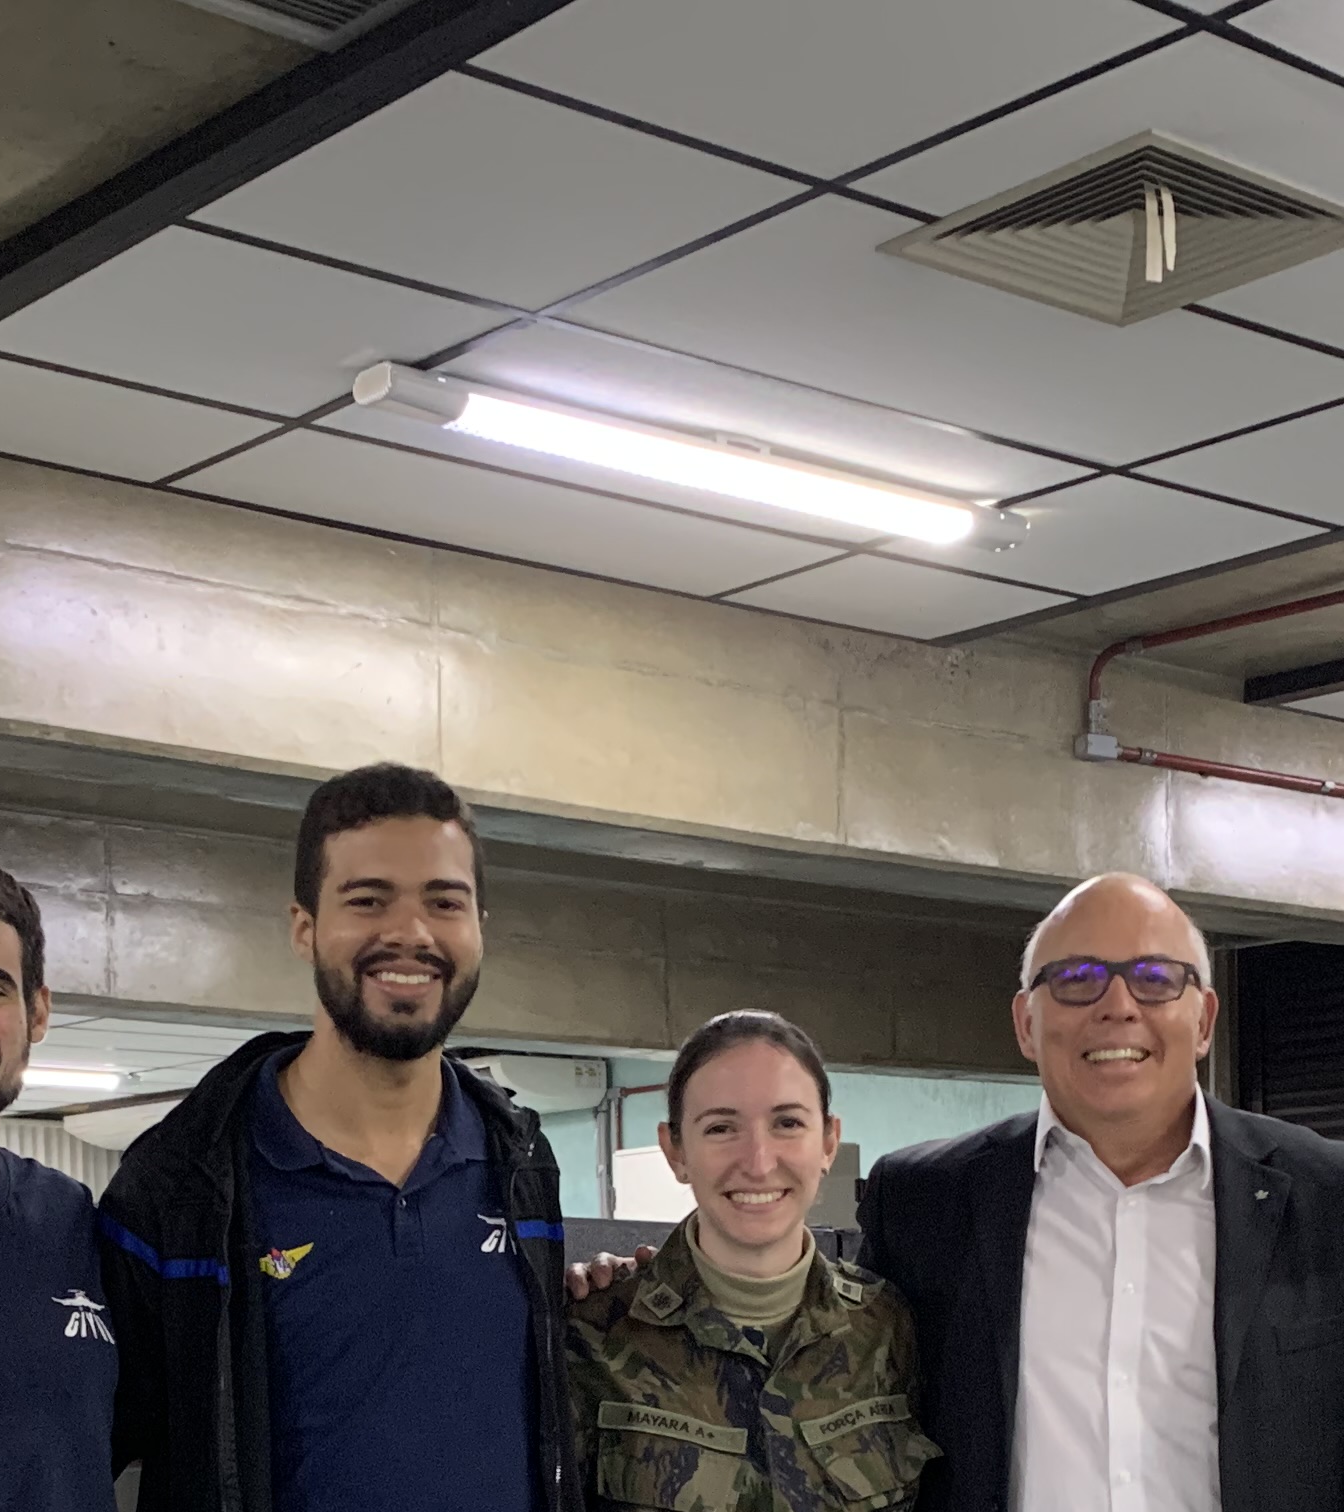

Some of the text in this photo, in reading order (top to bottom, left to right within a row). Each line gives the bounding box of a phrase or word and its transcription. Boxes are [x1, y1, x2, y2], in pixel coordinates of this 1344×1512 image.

[627, 1411, 715, 1439] MAYARA A+
[819, 1410, 866, 1434] FORÇA
